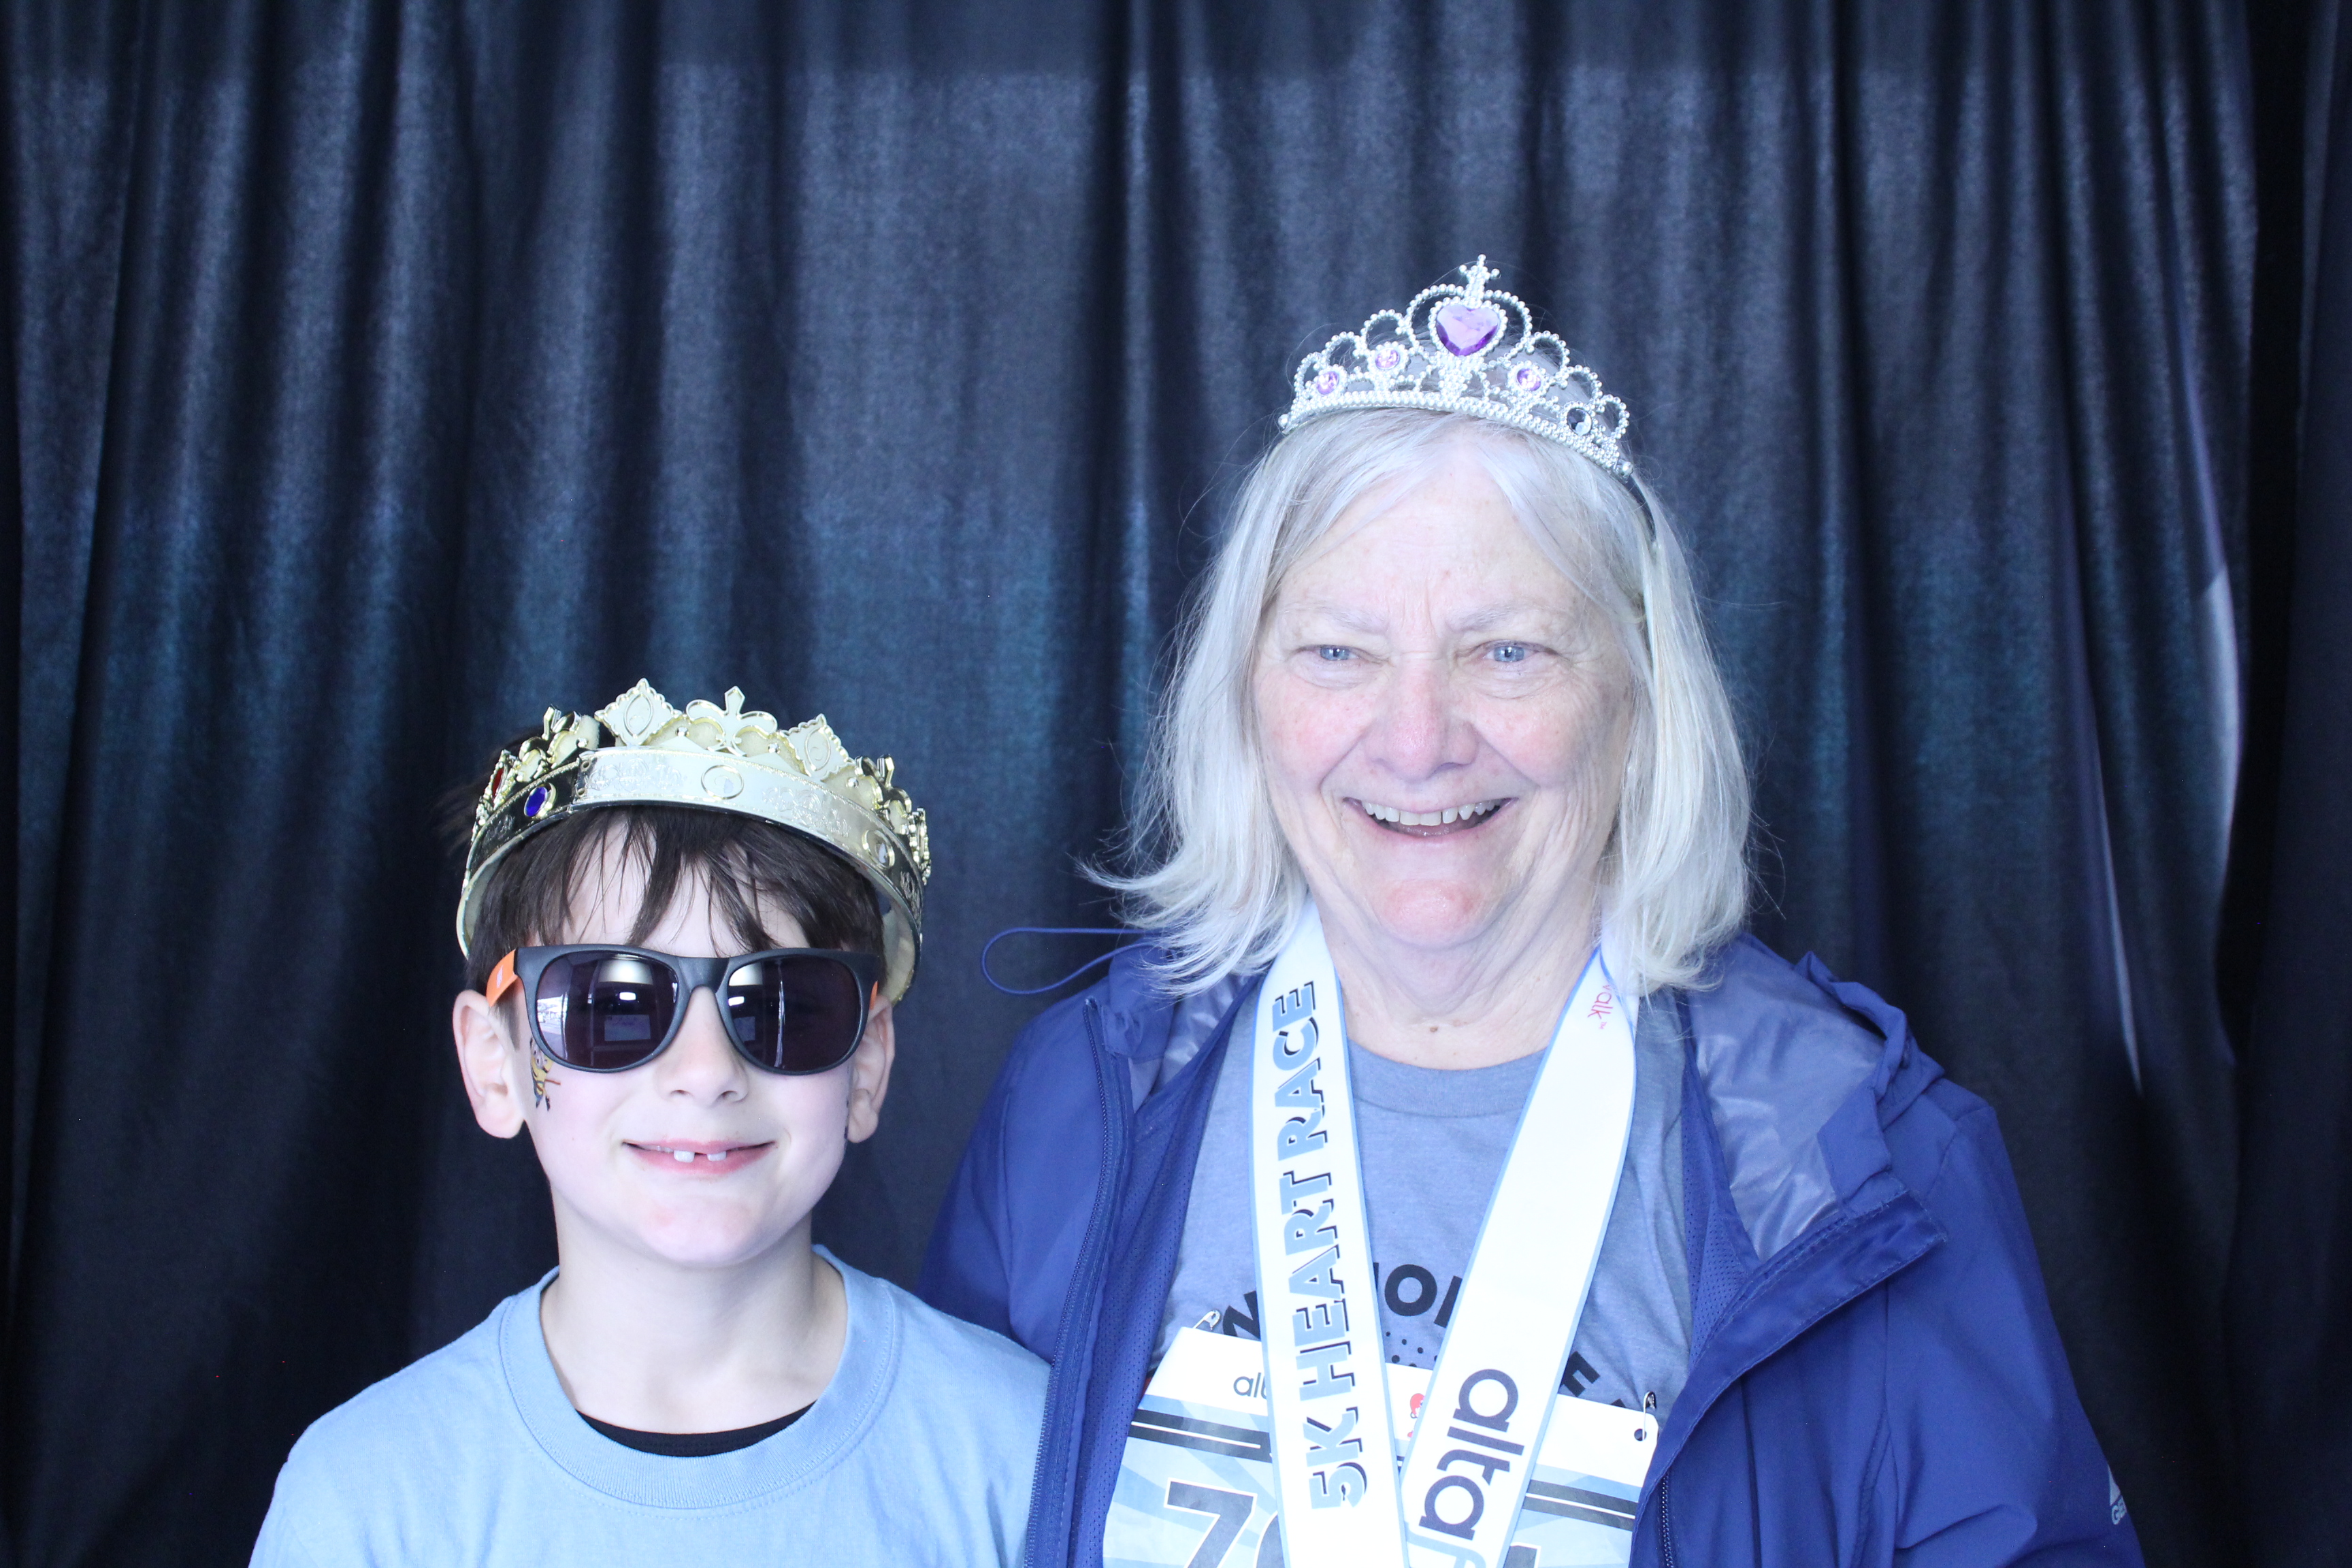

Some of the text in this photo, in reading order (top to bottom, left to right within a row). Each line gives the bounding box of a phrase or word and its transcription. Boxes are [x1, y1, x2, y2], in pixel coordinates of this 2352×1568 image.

[1272, 981, 1368, 1509] 5K HEART RACE
[1418, 1369, 1525, 1541] alta
